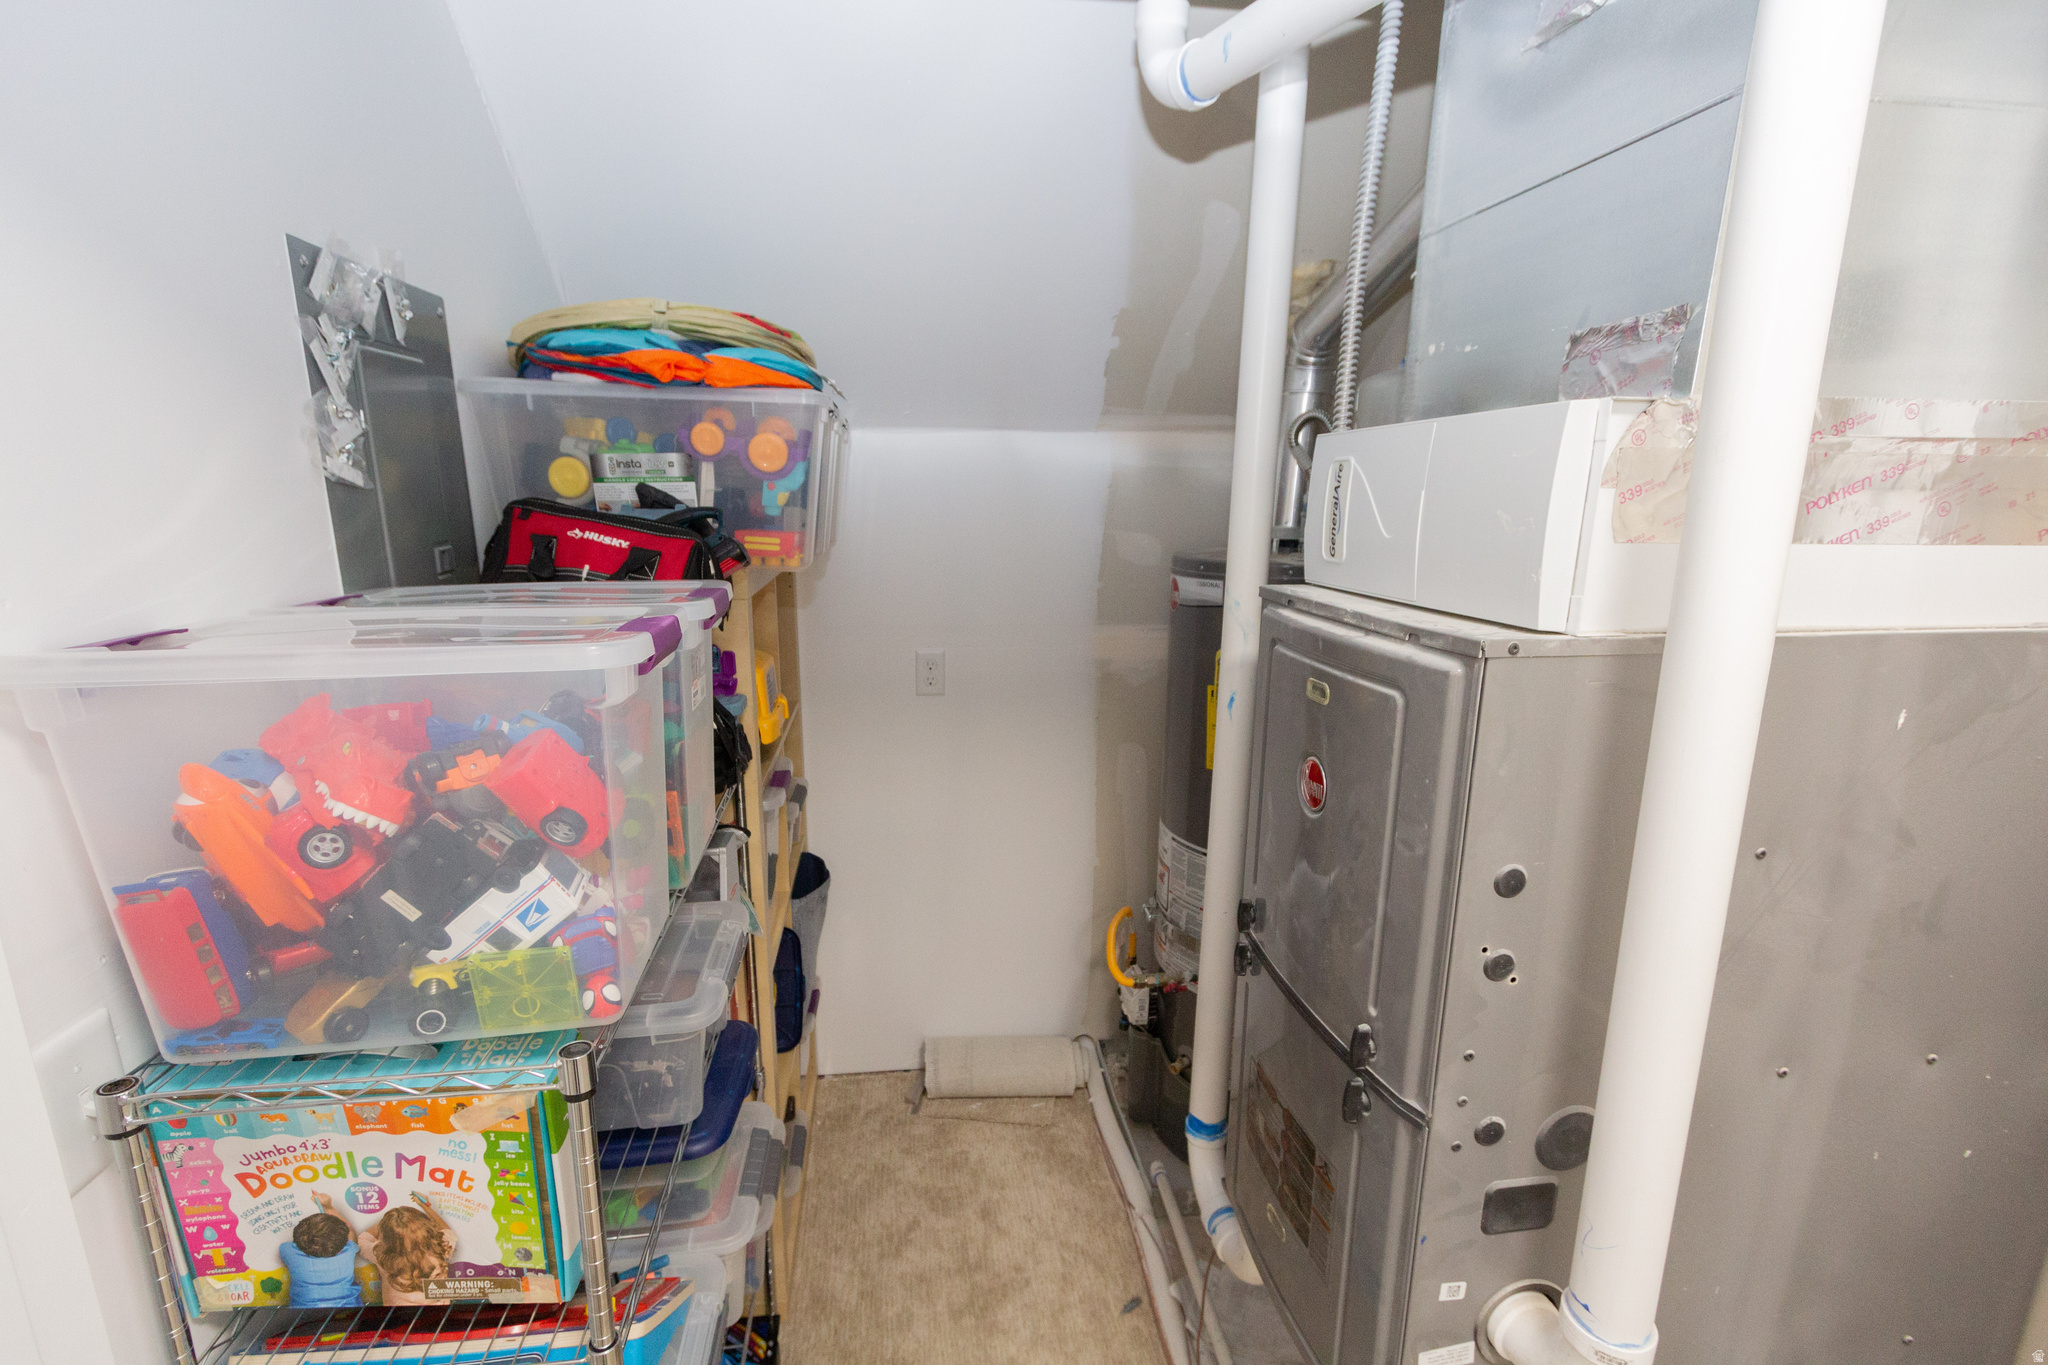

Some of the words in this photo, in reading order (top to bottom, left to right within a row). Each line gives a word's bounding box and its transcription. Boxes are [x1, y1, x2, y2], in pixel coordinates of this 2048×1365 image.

[1831, 417, 1855, 437] 339
[1880, 463, 1905, 482] 339
[1618, 484, 1643, 505] 339
[1866, 515, 1890, 535] 339
[583, 530, 630, 549] HUSKY
[448, 1138, 468, 1151] no
[239, 1144, 297, 1166] Jumbo
[255, 1156, 294, 1176] AQUA
[292, 1152, 332, 1164] DRAW
[437, 1146, 477, 1164] mess!
[234, 1151, 384, 1199] Doodle
[395, 1152, 475, 1194] Mat
[493, 1180, 509, 1188] jelly
[186, 1187, 211, 1196] yo-yo
[355, 1191, 380, 1204] 12
[185, 1214, 226, 1222] xylophone
[206, 1267, 237, 1275] volcano
[445, 1280, 494, 1289] WARNING:
